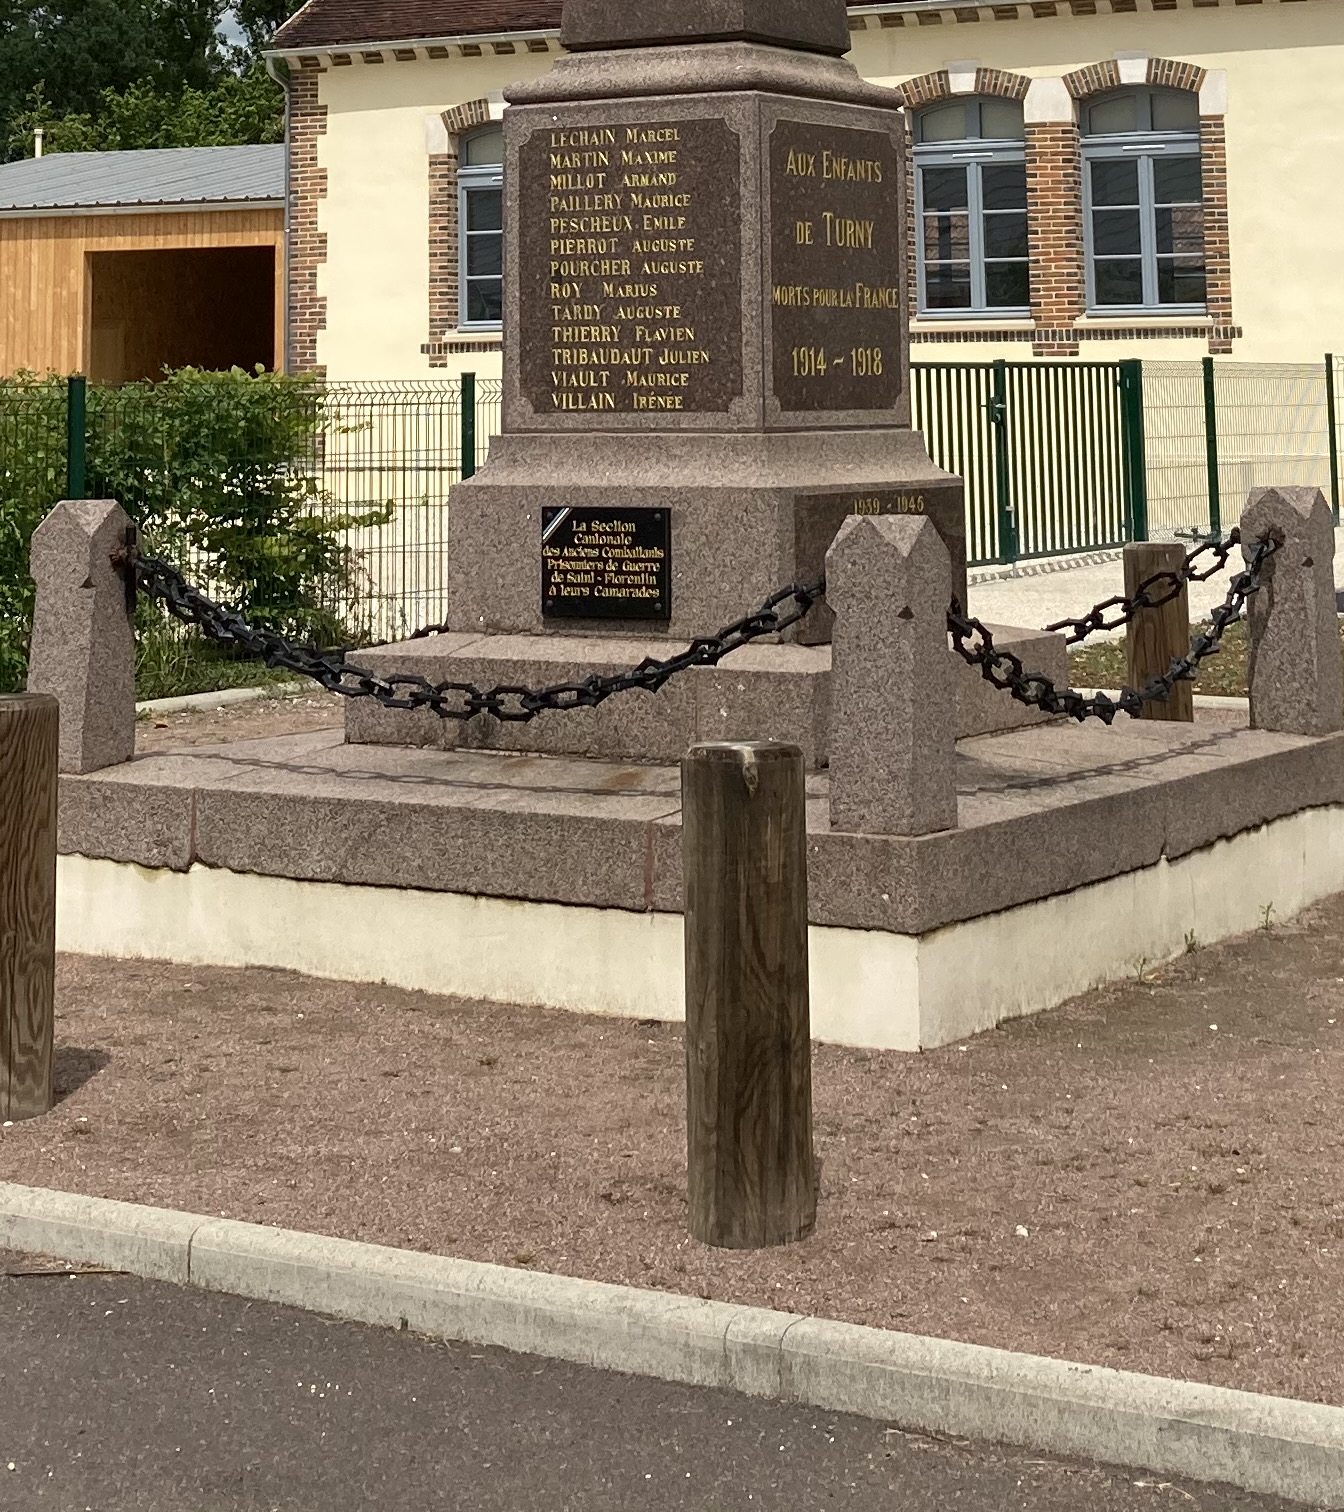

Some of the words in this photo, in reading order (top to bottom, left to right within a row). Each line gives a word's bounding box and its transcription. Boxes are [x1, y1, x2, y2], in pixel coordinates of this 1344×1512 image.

[551, 129, 615, 148] LECHAIN
[626, 128, 681, 144] MARCEL
[550, 151, 610, 169] MARTIN
[621, 150, 677, 165] MAXIME
[550, 173, 606, 190] MILLOT
[622, 173, 677, 187] ARMAND
[550, 194, 623, 212] PAILLERY
[631, 193, 691, 209] MAURICE
[550, 216, 633, 233] PESCHEUX
[796, 221, 814, 245] DE
[550, 238, 619, 255] PIERROT
[632, 239, 695, 253] AUGUSTE
[550, 259, 631, 277] POURCHER
[641, 260, 704, 275] AUGUSTE
[550, 282, 582, 299] ROY
[603, 281, 657, 298] MARIUS
[773, 285, 810, 306] MORTS
[813, 288, 838, 307] POUR
[840, 289, 853, 307] LA
[855, 282, 899, 309] FRANCE
[551, 304, 605, 320] TARDY
[615, 305, 681, 320] AUGUSTE
[551, 325, 621, 342] THIERRY
[635, 325, 695, 342] FLAVIEN
[659, 348, 710, 365] JULIEN
[792, 347, 827, 376] 1914
[850, 347, 883, 377] 1918
[551, 370, 610, 387] VIAULT
[626, 370, 689, 387] MAURICE
[551, 392, 615, 410] VILLAIN
[572, 520, 586, 532] La
[591, 519, 636, 533] Section
[574, 533, 633, 545] Cantonale
[542, 545, 560, 557] des
[561, 545, 599, 557] Anciens
[601, 546, 664, 559] Combattants
[547, 558, 604, 570] Prisonniers
[606, 559, 619, 571] de
[622, 560, 660, 572] Guerre
[551, 571, 565, 583] de
[560, 584, 590, 596] leurs
[594, 585, 660, 598] Camarades
